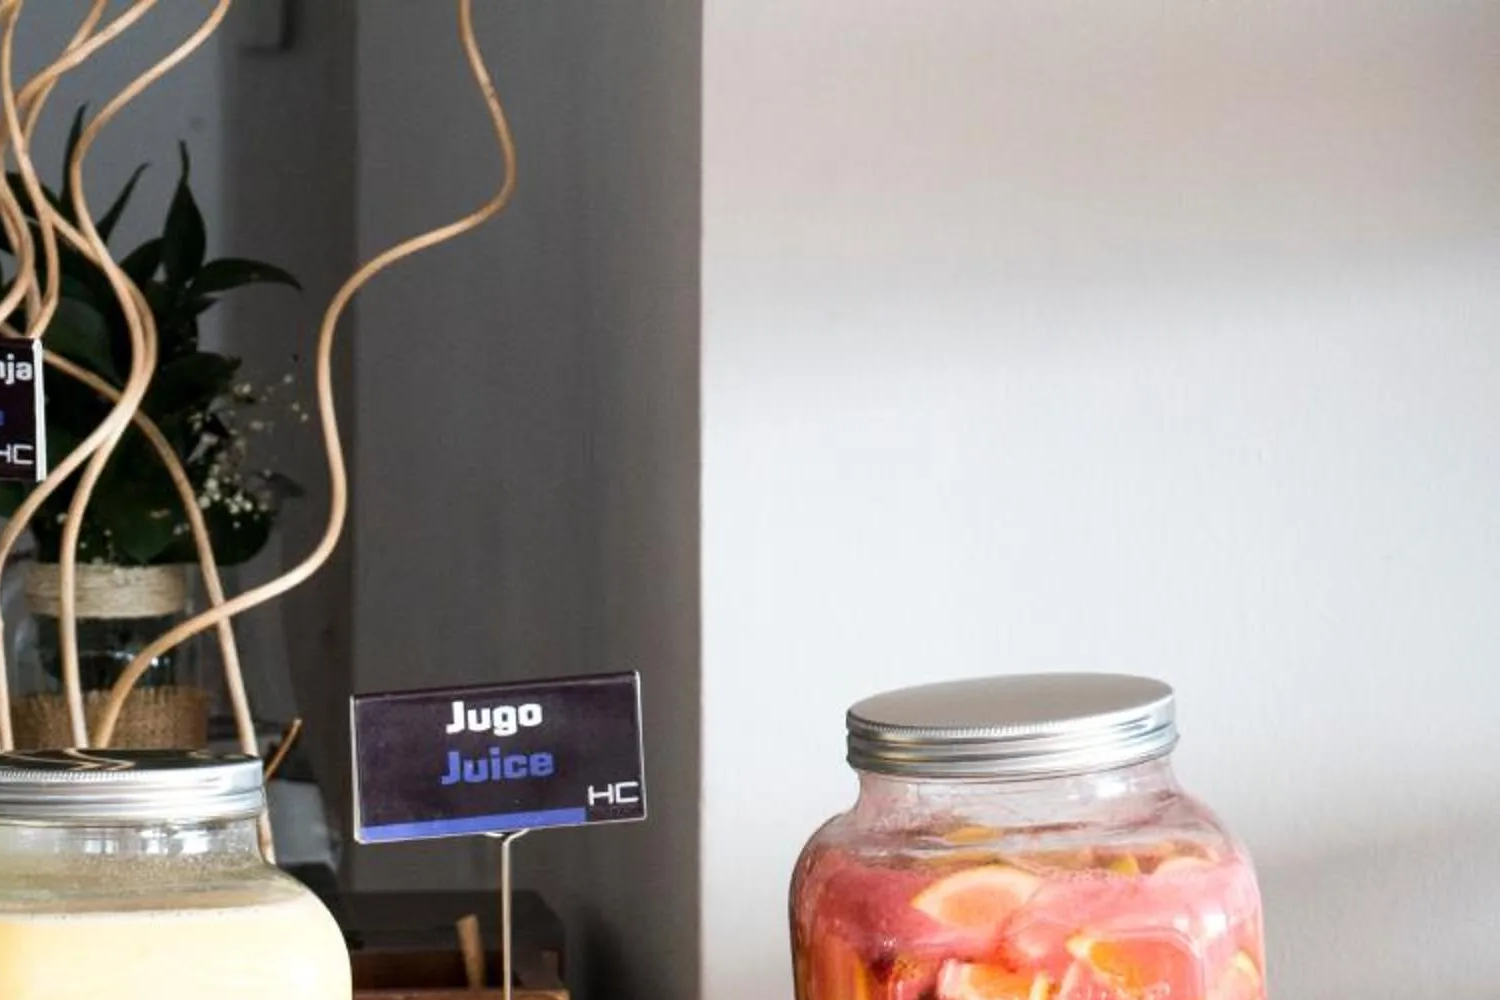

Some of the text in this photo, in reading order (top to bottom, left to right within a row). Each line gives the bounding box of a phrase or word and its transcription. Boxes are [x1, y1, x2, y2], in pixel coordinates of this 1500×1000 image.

[446, 701, 543, 736] Jugo
[441, 747, 554, 785] Juice
[588, 781, 639, 805] HC
